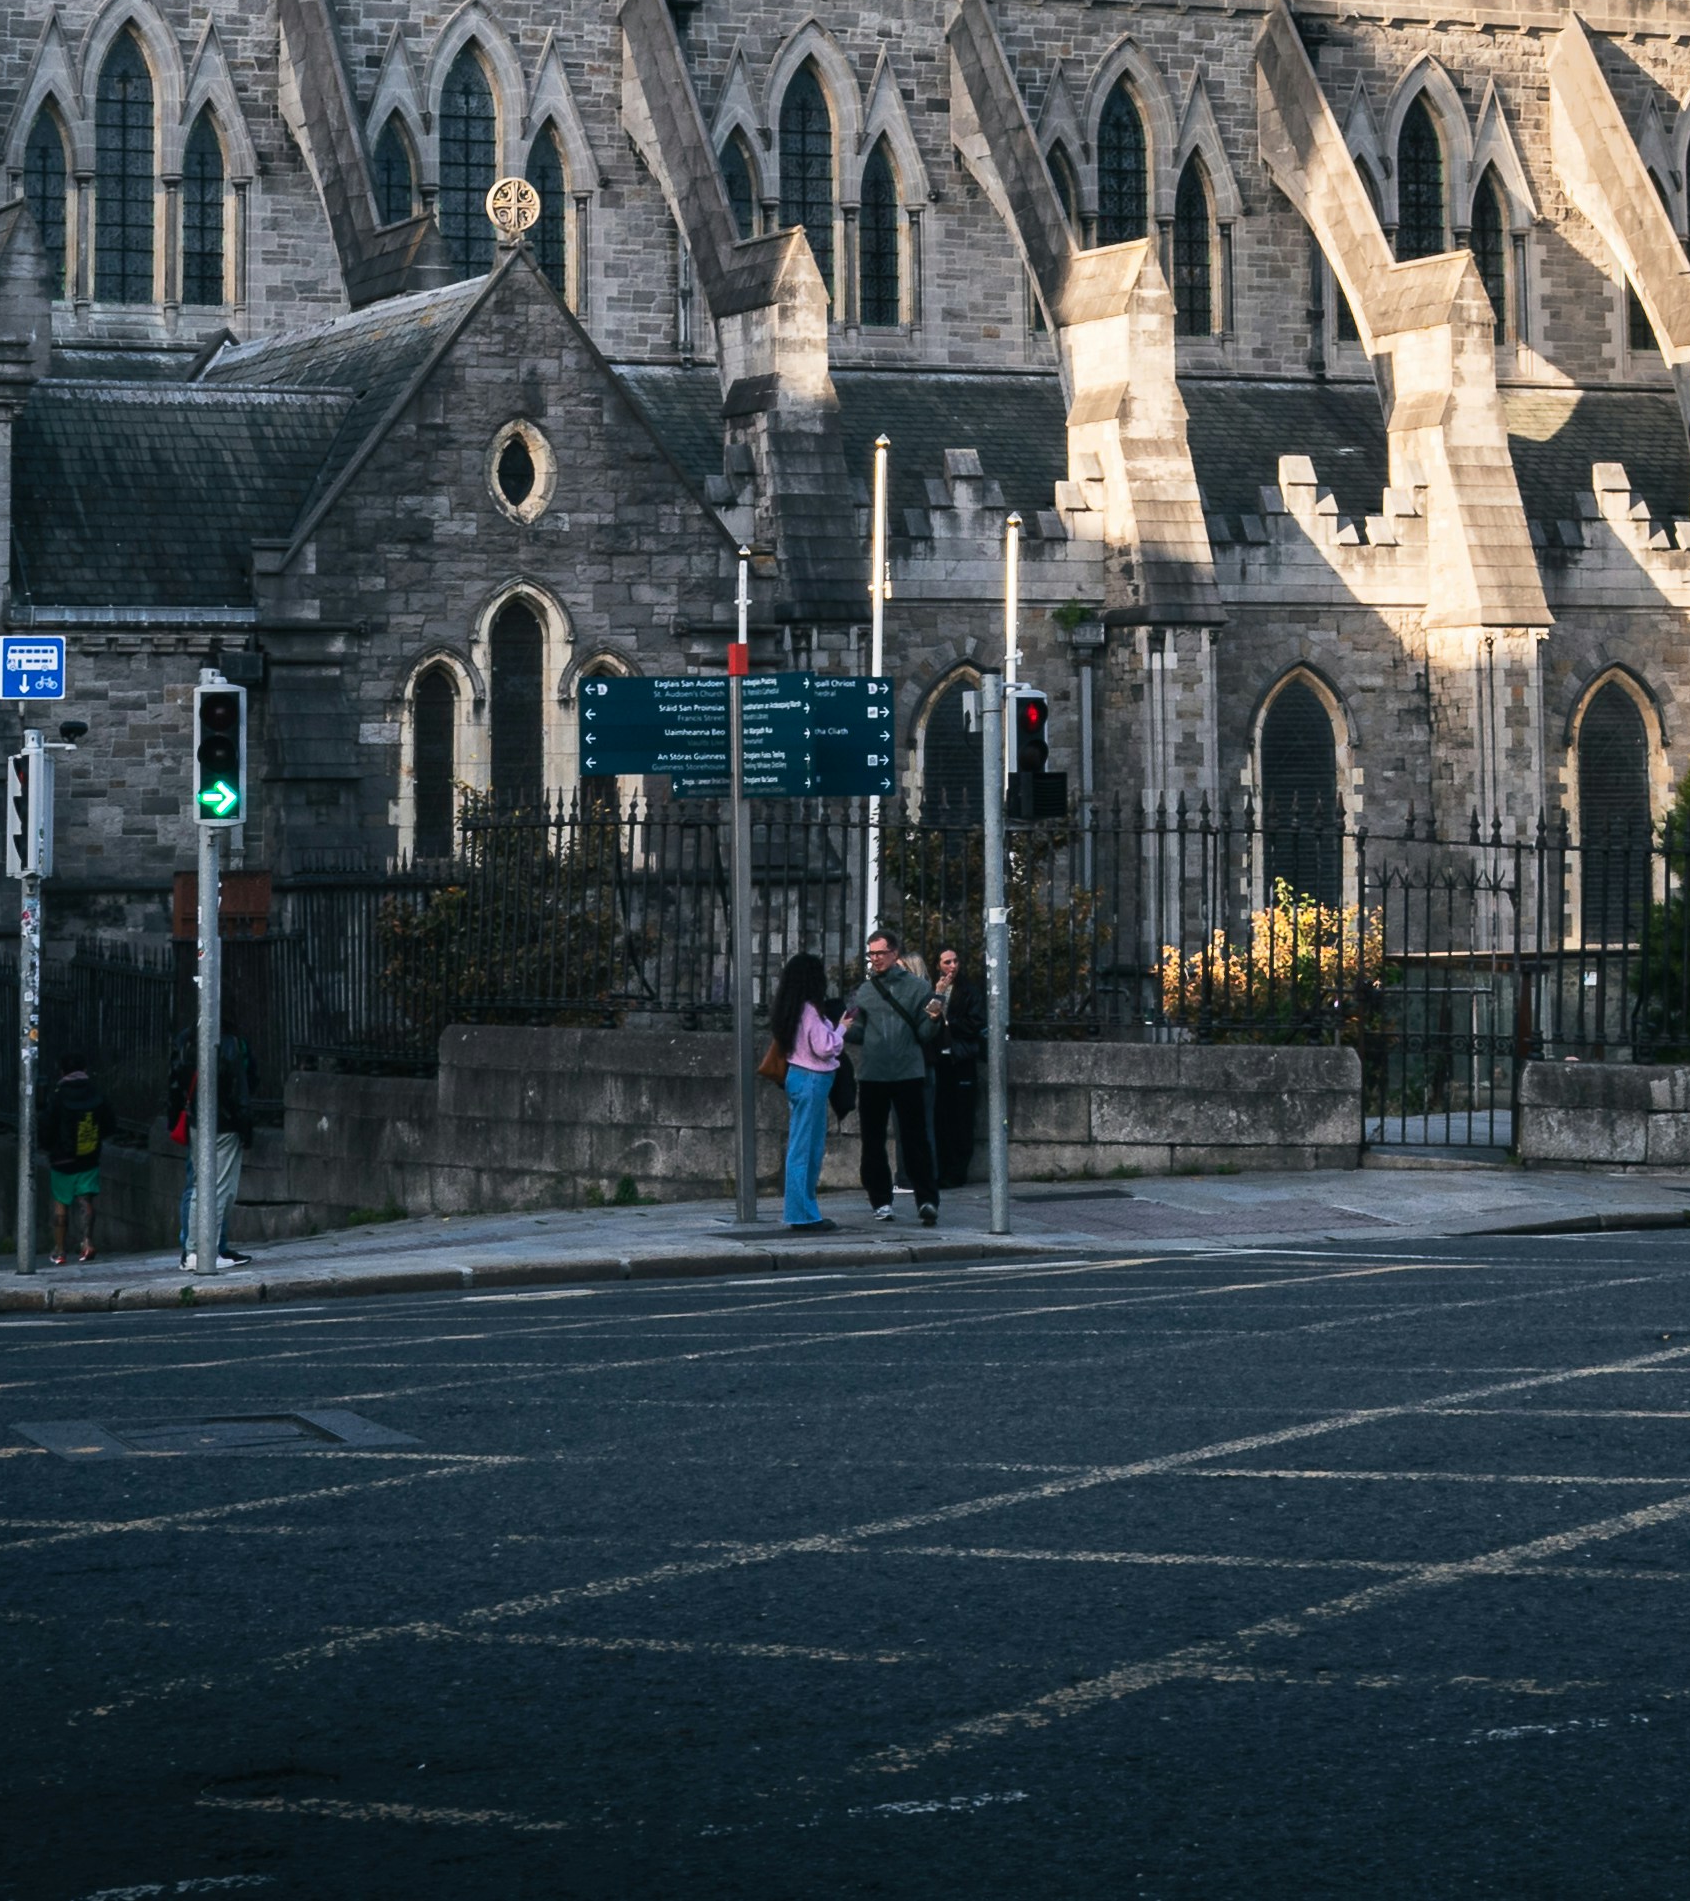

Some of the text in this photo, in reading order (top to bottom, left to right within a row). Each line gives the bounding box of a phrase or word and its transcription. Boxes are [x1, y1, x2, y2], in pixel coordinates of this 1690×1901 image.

[654, 680, 726, 690] Eaglais San Audoen
[665, 690, 698, 698] Audoen's
[700, 690, 726, 698] Church
[814, 689, 837, 698] hedral
[659, 704, 678, 712] Sráid
[694, 704, 726, 712] Proinsias
[677, 714, 726, 722] Francis Street
[827, 726, 849, 735] Cliath
[657, 753, 669, 761] An
[694, 753, 726, 761] Guinness
[652, 763, 726, 771] Guinness Storehouse
